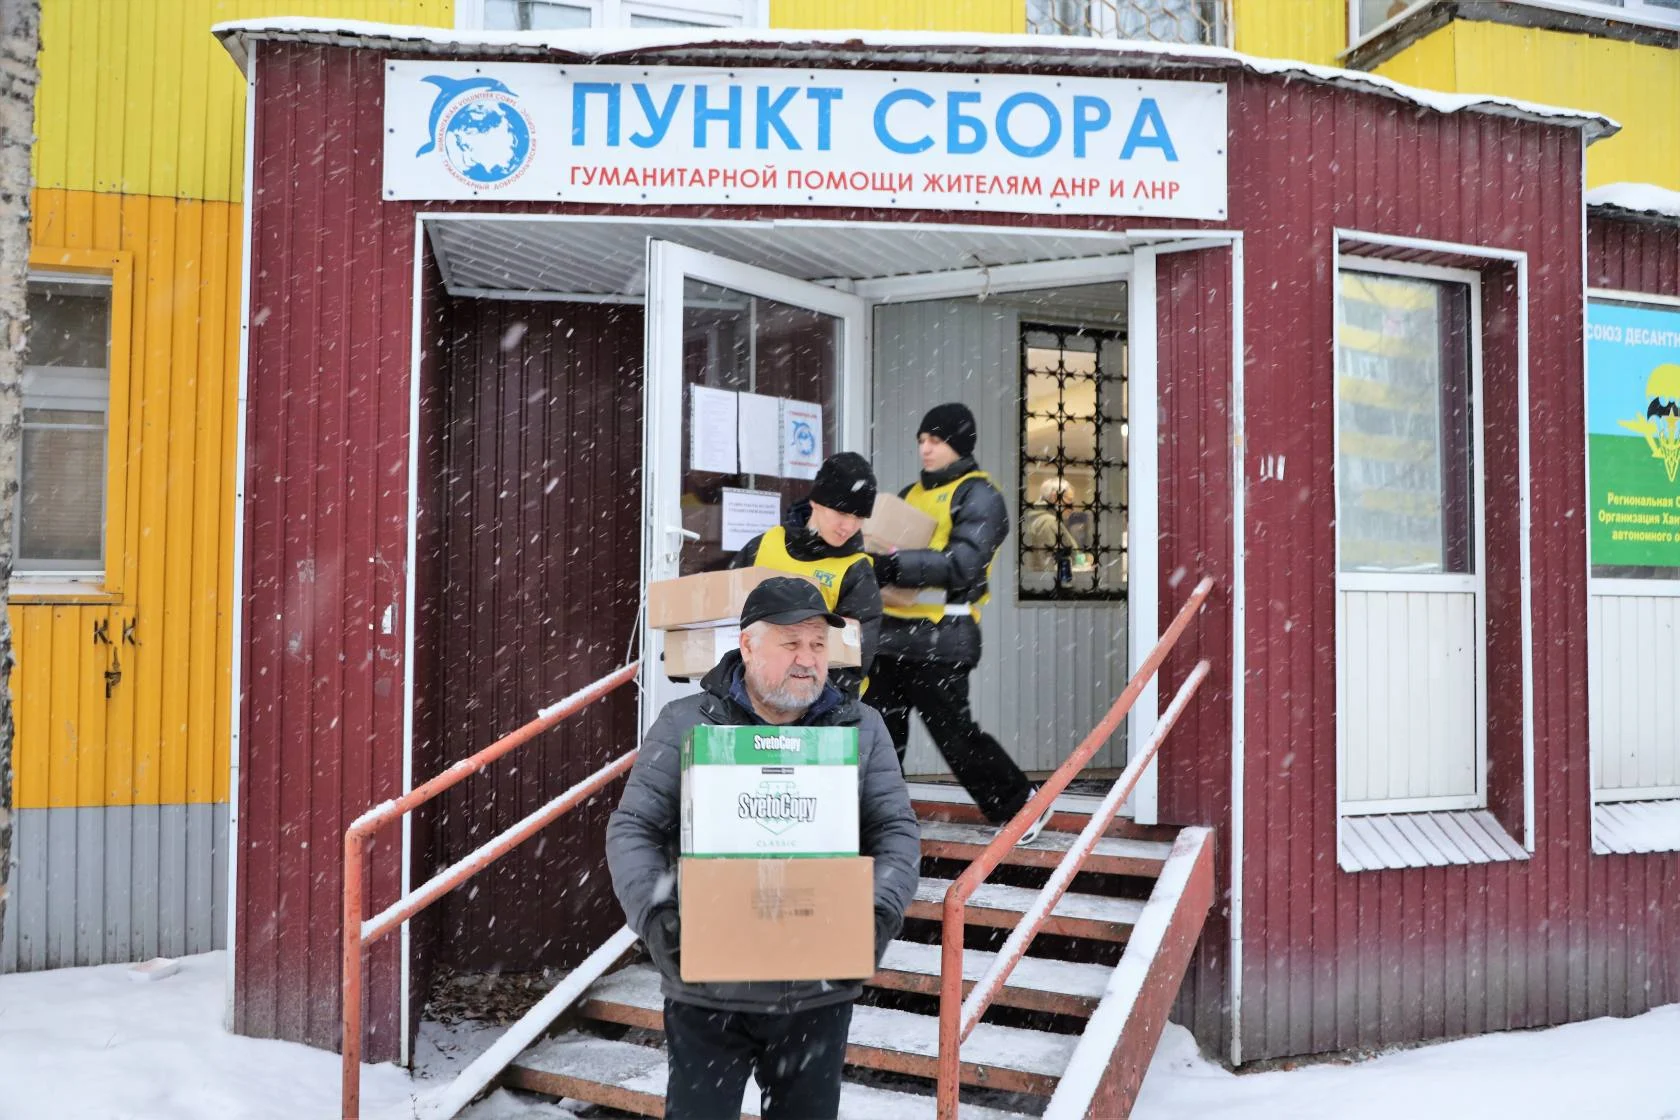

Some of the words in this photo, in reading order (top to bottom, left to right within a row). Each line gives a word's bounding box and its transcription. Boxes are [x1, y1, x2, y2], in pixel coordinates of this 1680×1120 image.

[571, 82, 844, 151] ПУНКТ
[873, 88, 1179, 162] СБОРА
[570, 165, 777, 190] ГУМАНИТАРНОЙ
[787, 168, 913, 193] ПОМОЩИ
[923, 173, 1043, 196] ЖИТЕЛЯМ
[1049, 176, 1100, 199] ДНР
[1109, 179, 1124, 199] И
[1133, 180, 1180, 200] ЛНР
[1587, 323, 1622, 342] СОЮЗ
[1608, 491, 1674, 508] Региональная
[1598, 510, 1660, 525] Организация
[1612, 531, 1672, 542] автономного
[754, 735, 801, 752] SvetoCopy
[738, 793, 816, 822] SvetoCopy
